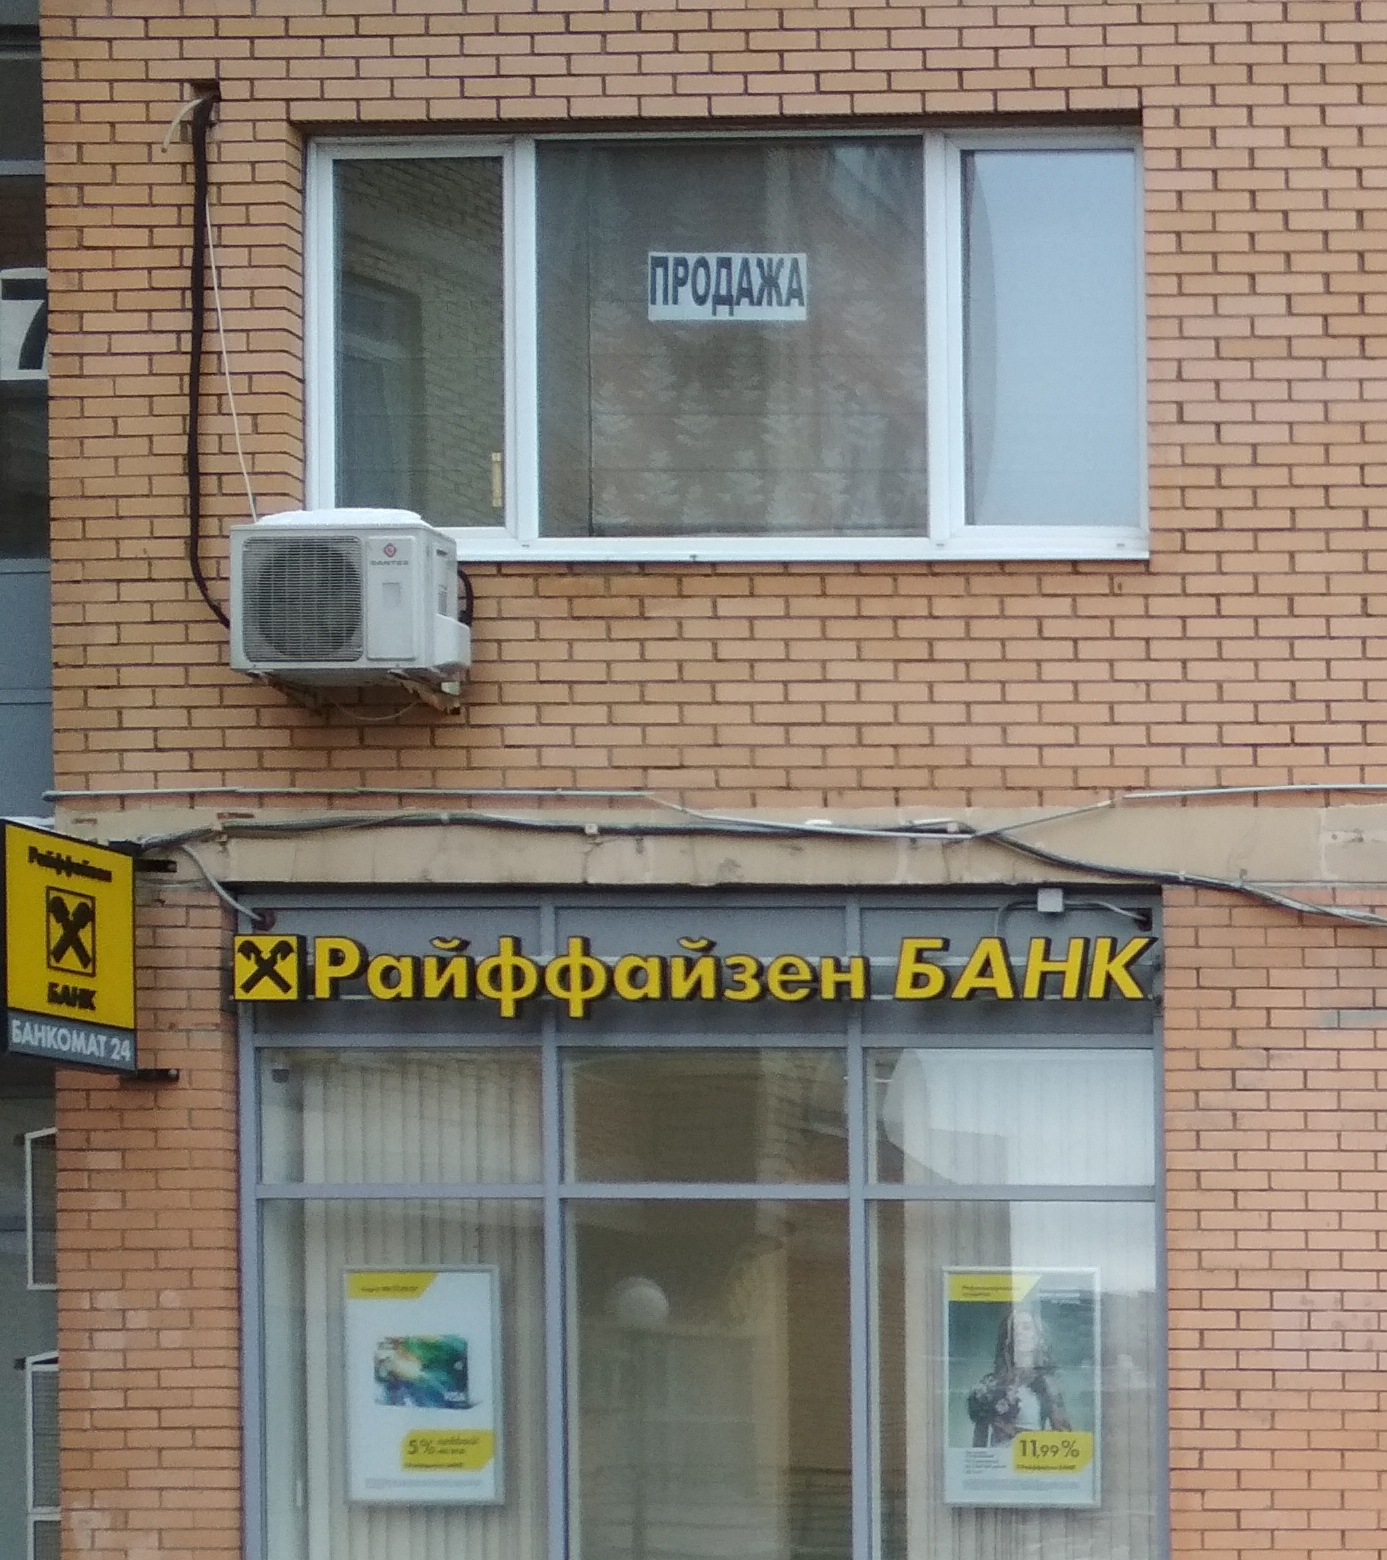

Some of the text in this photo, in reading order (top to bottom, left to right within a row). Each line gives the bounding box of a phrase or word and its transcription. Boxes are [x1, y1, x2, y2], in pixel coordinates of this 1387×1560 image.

[650, 256, 805, 317] ПРОДАЖА
[313, 935, 1158, 1018] Райффайзен БАНК
[11, 1019, 131, 1061] БАНКОМАТ 24
